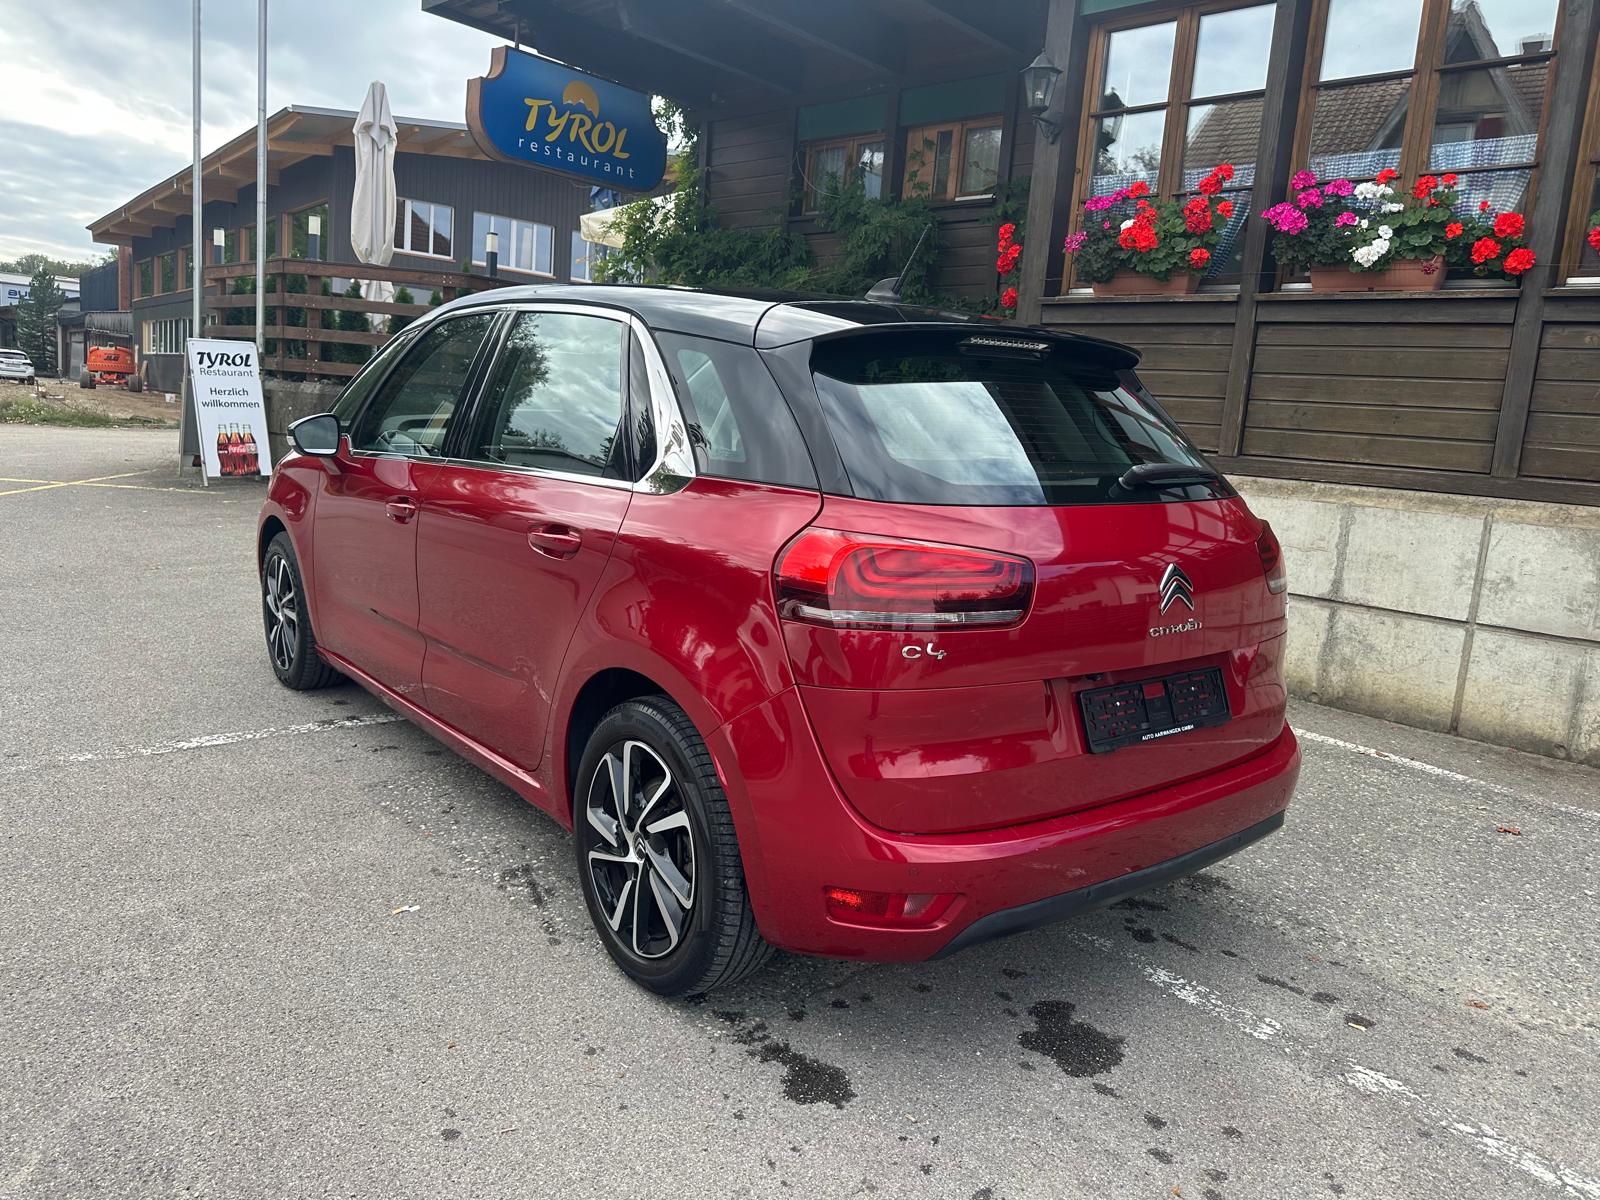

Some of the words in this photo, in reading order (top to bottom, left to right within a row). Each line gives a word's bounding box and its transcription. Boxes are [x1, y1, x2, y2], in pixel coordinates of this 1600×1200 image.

[524, 98, 630, 159] TYROL
[518, 138, 635, 179] restaurant
[197, 352, 252, 368] TYROL
[200, 368, 253, 377] Restaurant
[210, 387, 249, 396] Herzlich
[202, 399, 260, 408] willkommen
[902, 642, 947, 660] C4
[1142, 733, 1154, 741] AUTO
